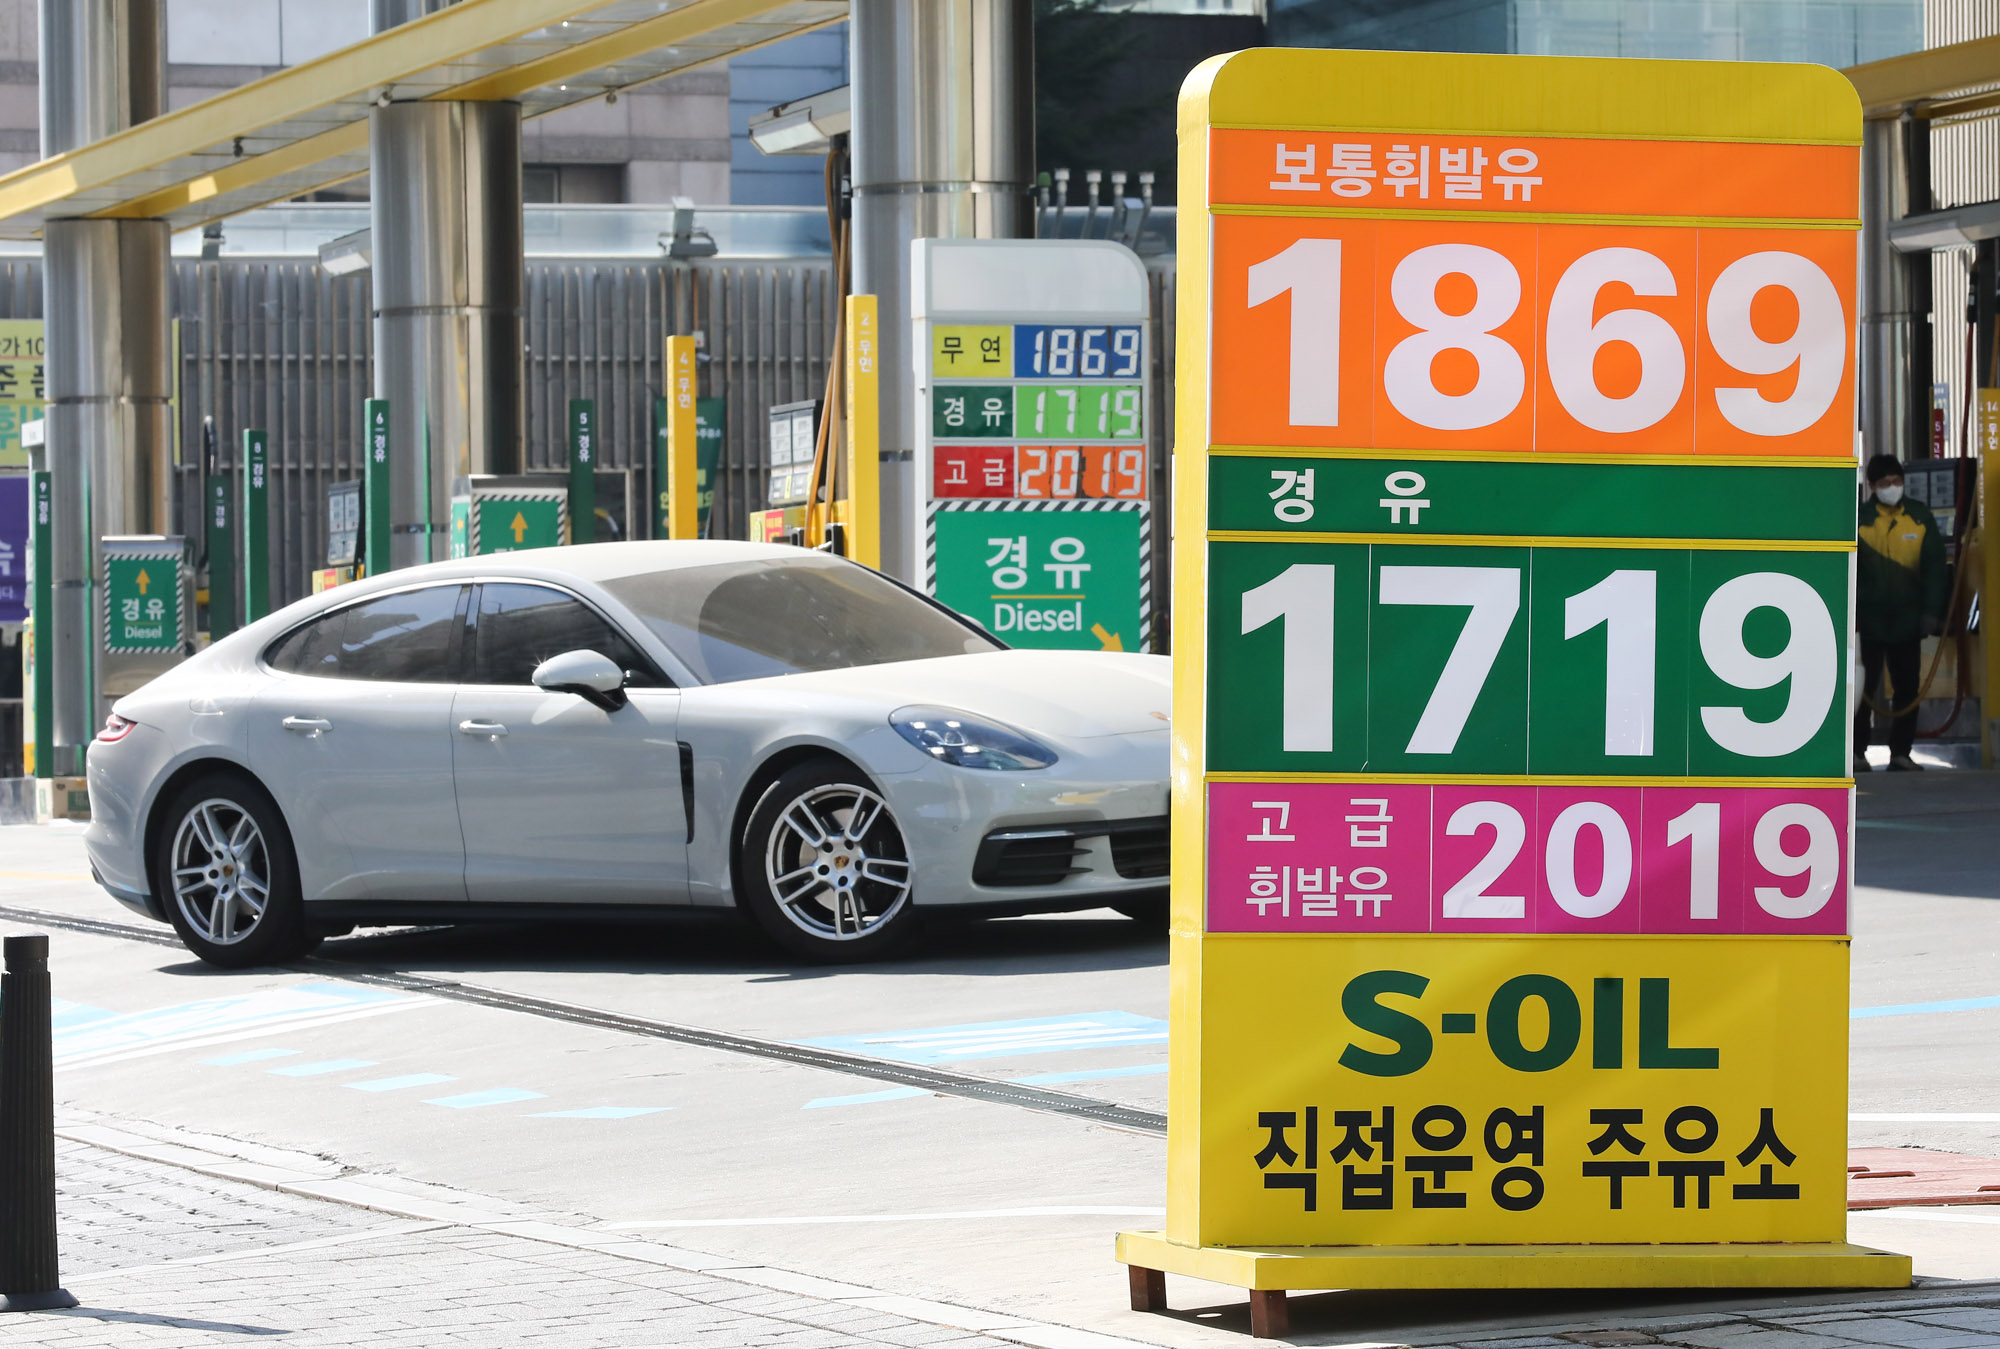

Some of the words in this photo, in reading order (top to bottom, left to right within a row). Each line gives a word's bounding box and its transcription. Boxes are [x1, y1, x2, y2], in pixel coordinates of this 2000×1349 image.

[1269, 143, 1543, 202] 보통휘발유
[679, 352, 689, 364] 4
[1033, 329, 1140, 375] 1869
[1247, 238, 1846, 436] 1869
[376, 412, 384, 424] 6
[579, 412, 588, 425] 5
[1034, 389, 1140, 436] 1719
[1020, 449, 1143, 496] 2019
[125, 625, 162, 639] Diesel
[994, 601, 1082, 632] Diesel
[1241, 563, 1839, 758] 1719
[1442, 800, 1840, 920] 2019
[1245, 865, 1393, 917] 휘발유
[1337, 969, 1720, 1077] S-OIL
[1254, 1104, 1545, 1212] 직접운영
[1582, 1105, 1800, 1210] 주유소
